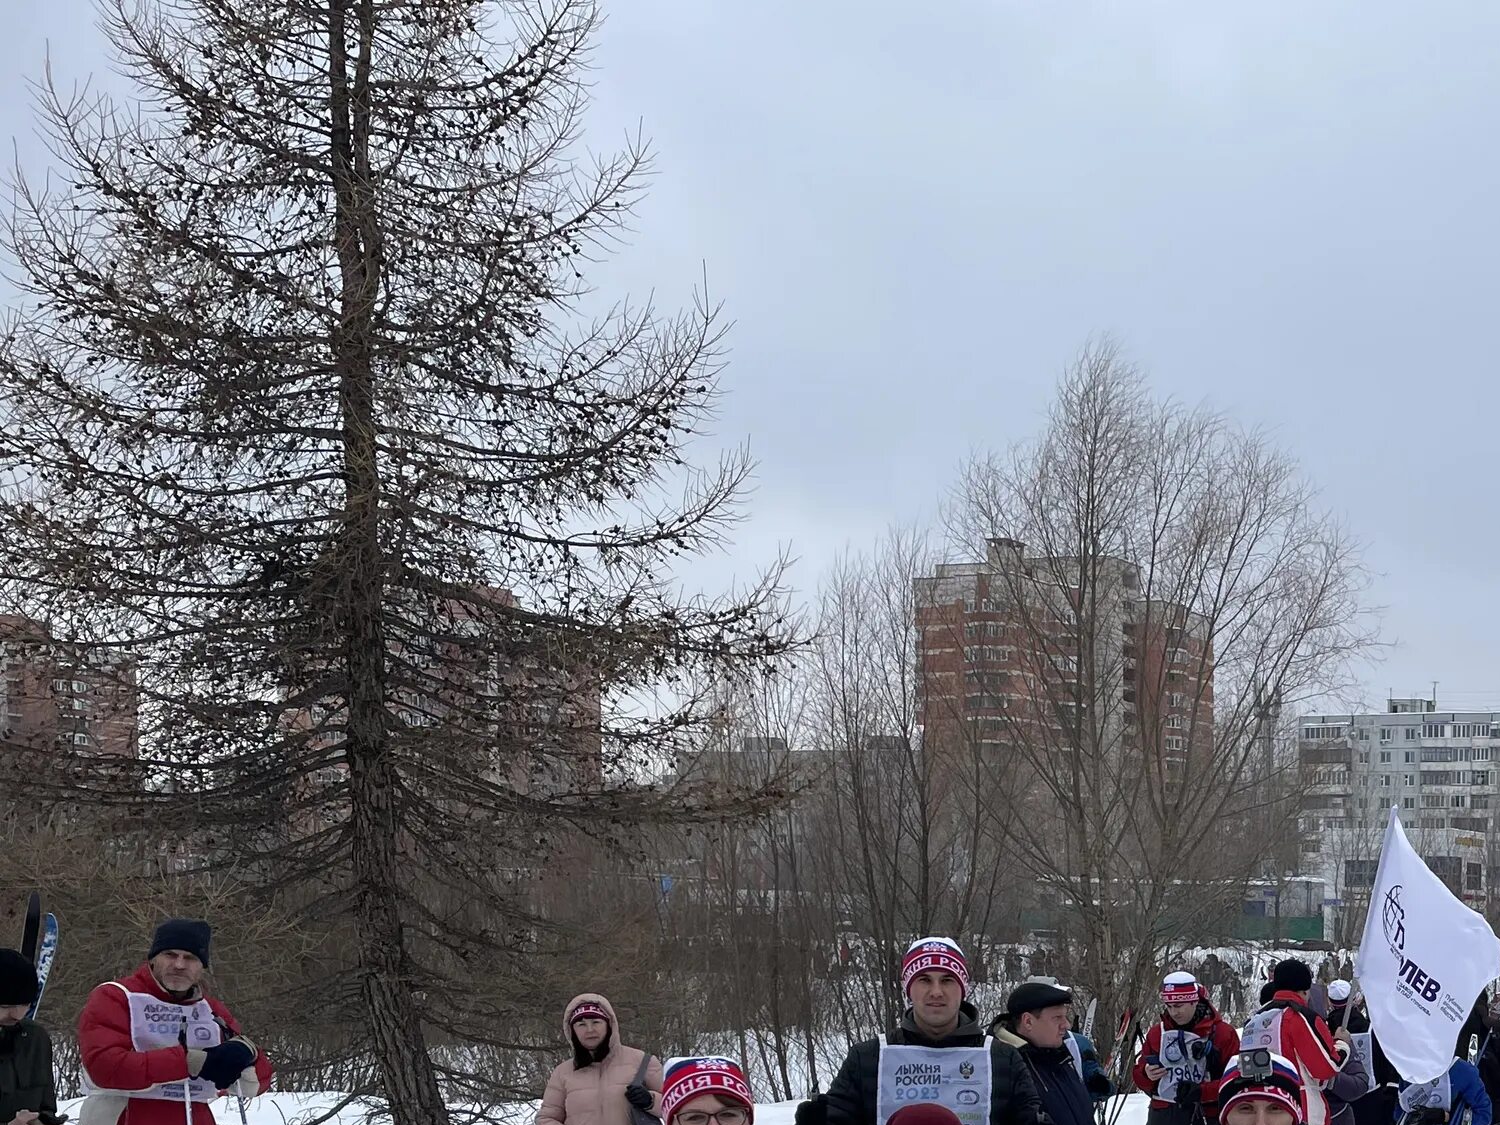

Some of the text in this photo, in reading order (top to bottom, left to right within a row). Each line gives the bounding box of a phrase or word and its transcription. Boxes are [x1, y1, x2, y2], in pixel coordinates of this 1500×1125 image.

[895, 1064, 941, 1076] ЛЫЖНЯ
[895, 1074, 941, 1087] РОССИИ
[895, 1087, 940, 1101] 2023
